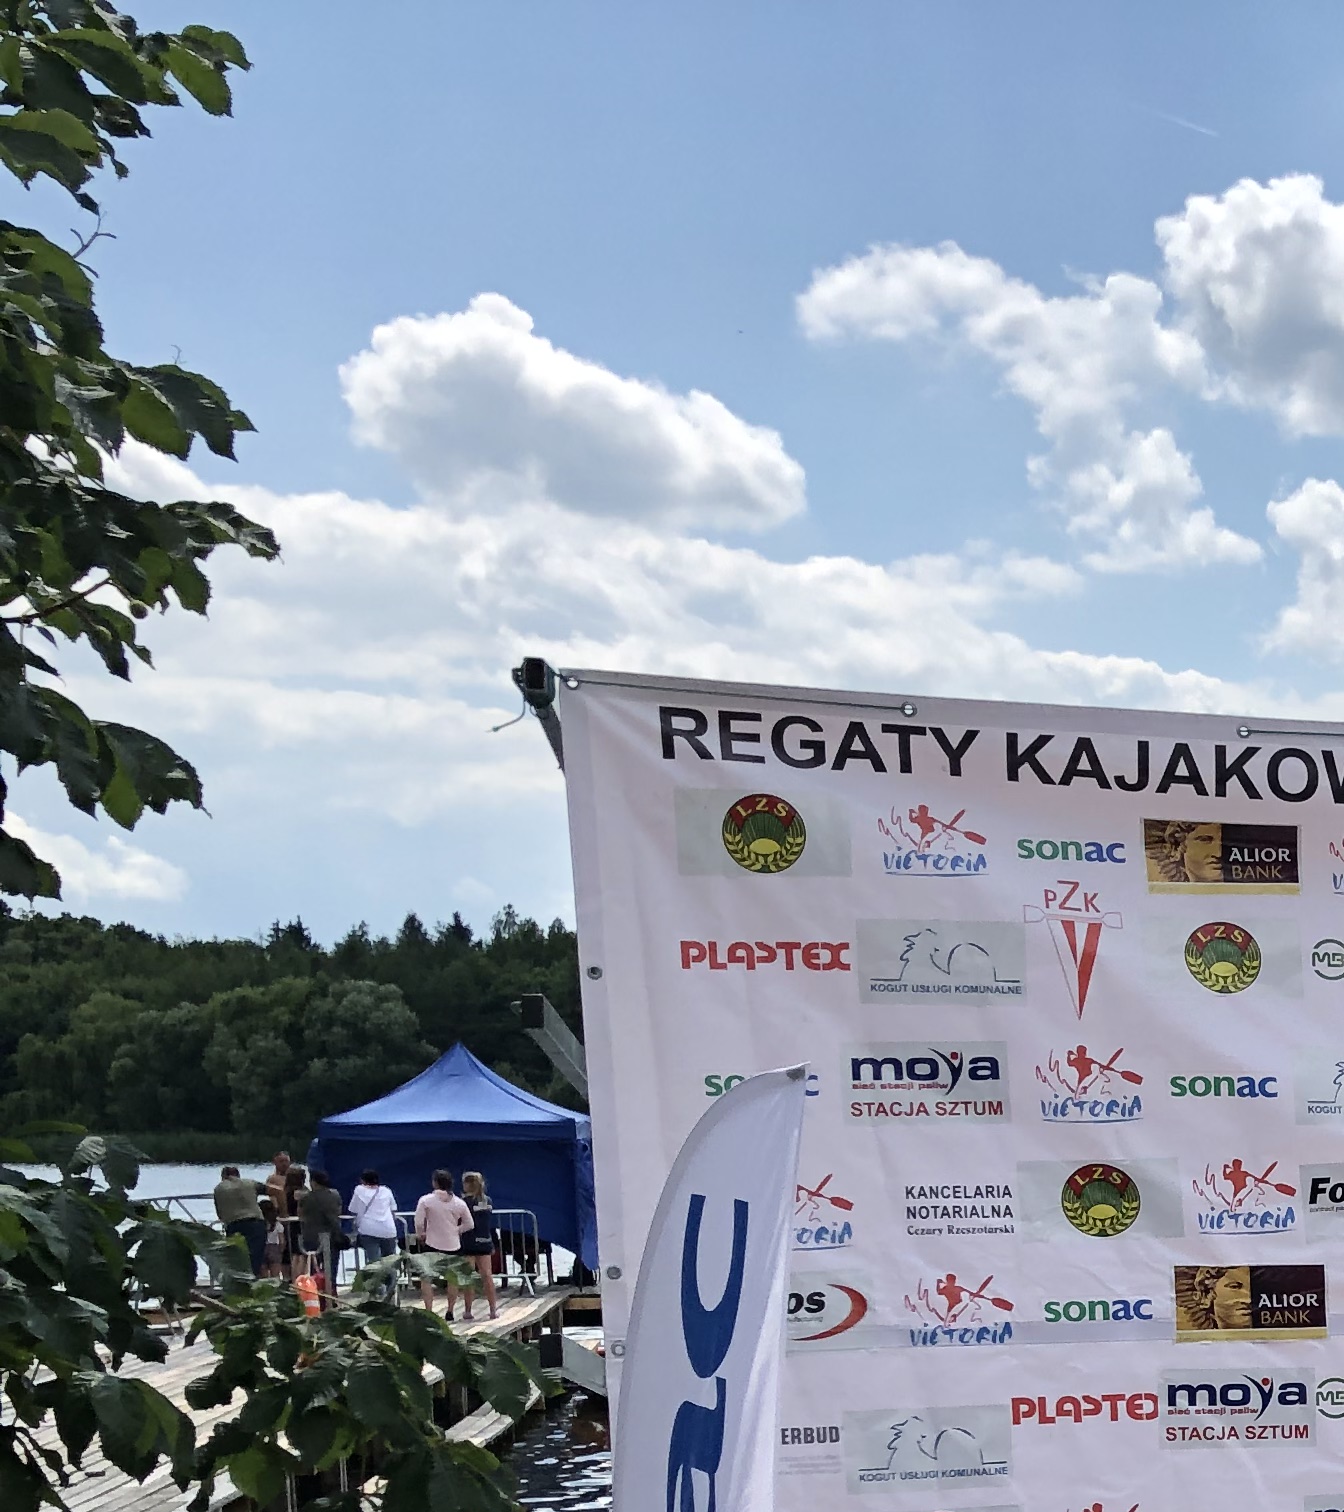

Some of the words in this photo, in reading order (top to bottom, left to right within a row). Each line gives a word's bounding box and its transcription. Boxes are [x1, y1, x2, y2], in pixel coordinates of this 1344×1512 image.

[659, 706, 979, 777] REGATY
[737, 797, 788, 818] LZS
[1017, 839, 1127, 863] sonac
[1229, 847, 1292, 863] ALIOR
[1232, 865, 1282, 879] BANK
[1043, 881, 1101, 912] PZK
[1197, 927, 1245, 943] LZS
[680, 940, 851, 971] PLASTEX
[870, 984, 908, 994] KOGUT
[912, 984, 952, 994] USŁUGI
[955, 984, 1022, 994] KOMUNALNE
[851, 1048, 1000, 1095] moya
[1171, 1075, 1278, 1097] sonac
[851, 1102, 930, 1117] STACJA
[935, 1101, 1004, 1115] SZTUM
[1308, 1105, 1341, 1114] KOGUT
[1074, 1168, 1122, 1186] LZS
[905, 1185, 1012, 1200] KANCELARIA
[907, 1206, 1014, 1219] NOTARIALNA
[907, 1226, 943, 1236] Cezary
[947, 1224, 1015, 1235] Rzeszotarski
[1259, 1294, 1318, 1308] ALIOR
[1045, 1300, 1152, 1321] sonac
[1261, 1310, 1310, 1324] BANK
[1168, 1375, 1307, 1420] moya
[781, 1427, 840, 1445] ERBUD
[1166, 1426, 1239, 1442] STACJA
[1245, 1424, 1309, 1440] SZTUM
[859, 1471, 896, 1482] KOGUT
[941, 1466, 1008, 1478] KOMUNALNE
